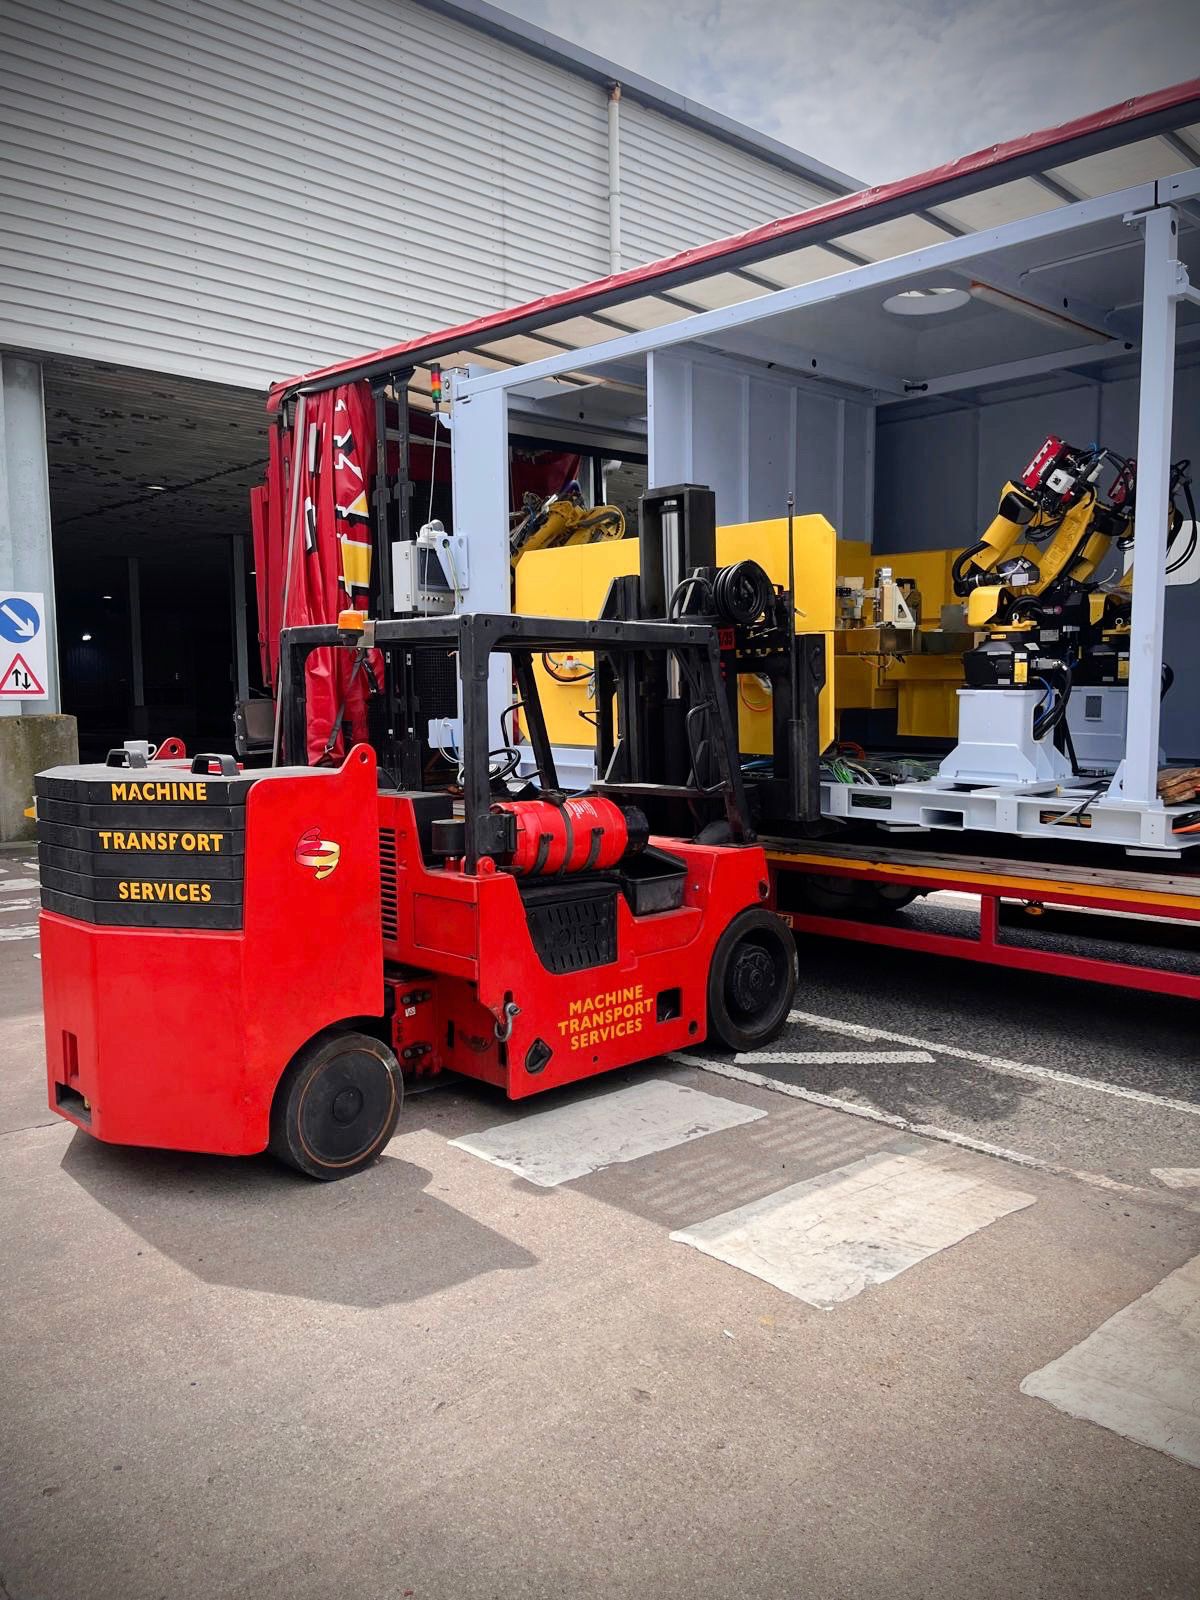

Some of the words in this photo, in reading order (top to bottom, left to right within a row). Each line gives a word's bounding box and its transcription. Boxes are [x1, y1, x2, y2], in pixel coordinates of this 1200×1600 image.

[111, 782, 207, 801] MACHINE
[118, 881, 212, 902] SERVICES
[569, 984, 643, 1017] MACHINE
[558, 998, 654, 1036] TRANSPORT
[570, 1018, 642, 1050] SERVICES
